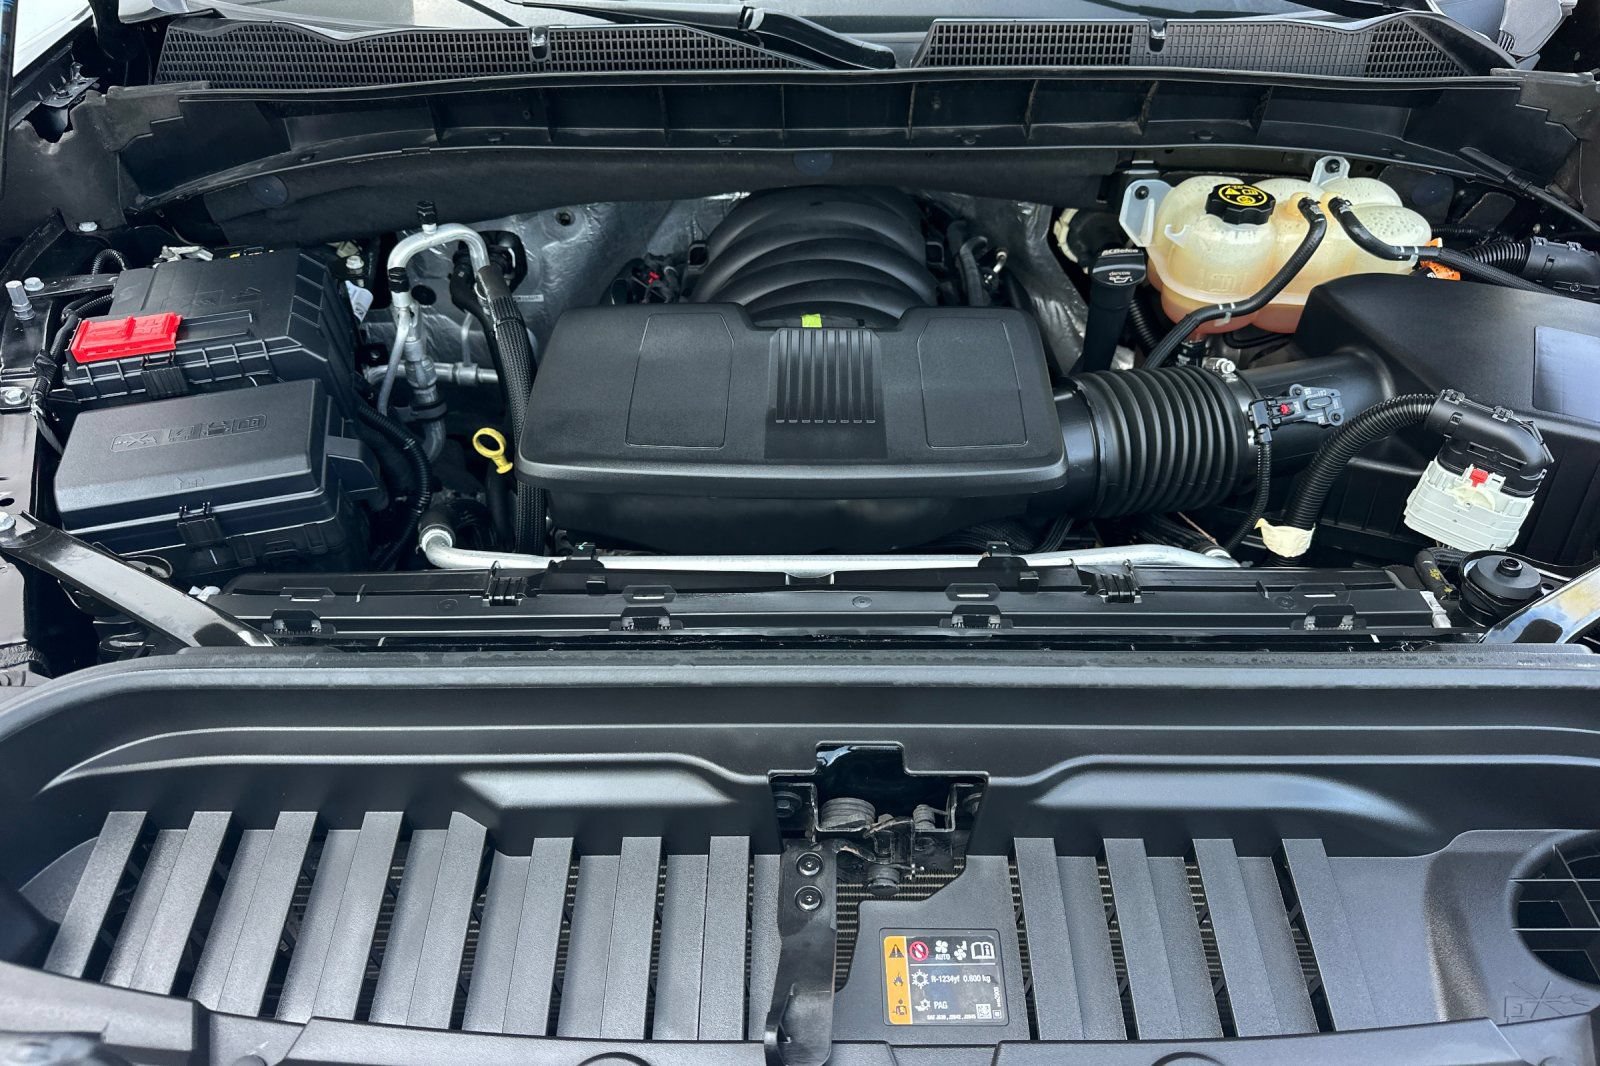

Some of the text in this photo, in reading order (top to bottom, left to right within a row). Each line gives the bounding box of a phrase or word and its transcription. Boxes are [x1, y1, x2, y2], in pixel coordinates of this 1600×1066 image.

[1101, 248, 1139, 256] ACDelco
[930, 975, 960, 984] R-1234yf
[982, 974, 991, 983] kg
[933, 1001, 948, 1010] PAG
